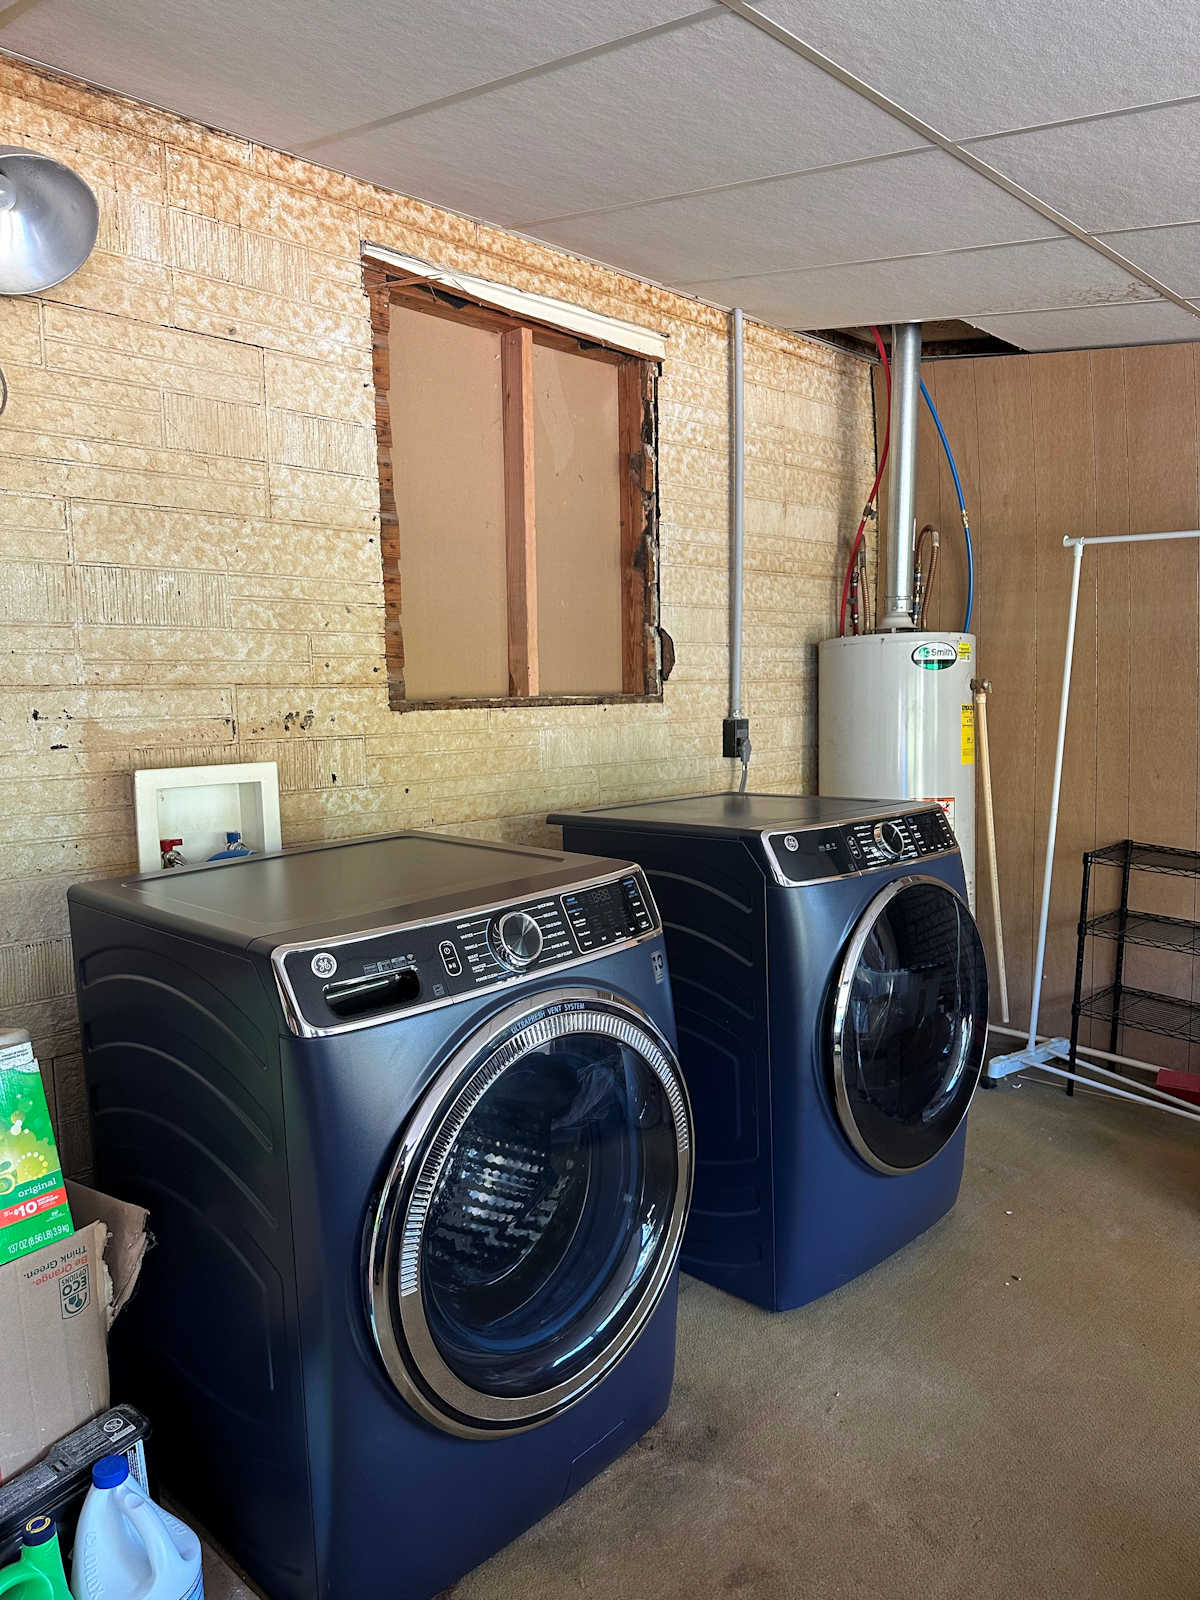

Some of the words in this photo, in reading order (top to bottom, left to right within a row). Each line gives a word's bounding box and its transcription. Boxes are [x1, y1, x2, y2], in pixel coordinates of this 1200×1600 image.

[931, 648, 953, 657] Smith
[510, 1009, 546, 1034] ULTRAFRESH
[547, 1005, 562, 1016] VENT
[564, 1002, 585, 1012] SYSTEM
[18, 1177, 57, 1198] original
[7, 1242, 18, 1254] 137
[19, 1238, 28, 1250] OZ
[53, 1224, 62, 1237] 3.9
[60, 1245, 88, 1263] Think
[75, 1255, 89, 1267] Be
[23, 1260, 58, 1280] Green.
[32, 1263, 73, 1286] Orange.
[61, 1268, 87, 1287] OPTIONS
[62, 1275, 87, 1297] ECO
